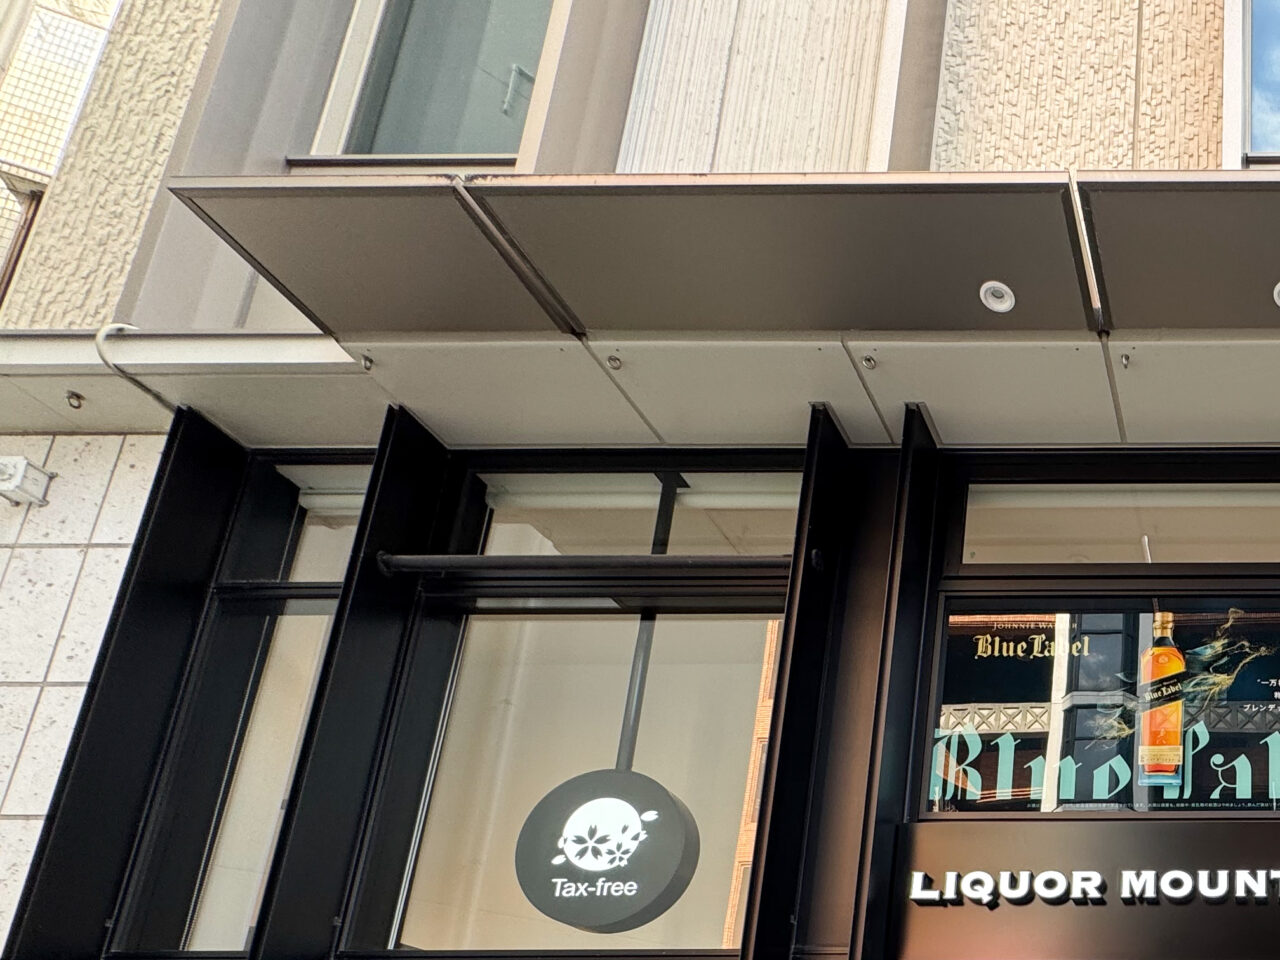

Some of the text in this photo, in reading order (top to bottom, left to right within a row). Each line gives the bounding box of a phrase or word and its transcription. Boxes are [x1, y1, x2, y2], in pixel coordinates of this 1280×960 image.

[973, 633, 1027, 659] Blue
[552, 877, 638, 897] Tax-free
[909, 869, 1102, 902] LIQUOR
